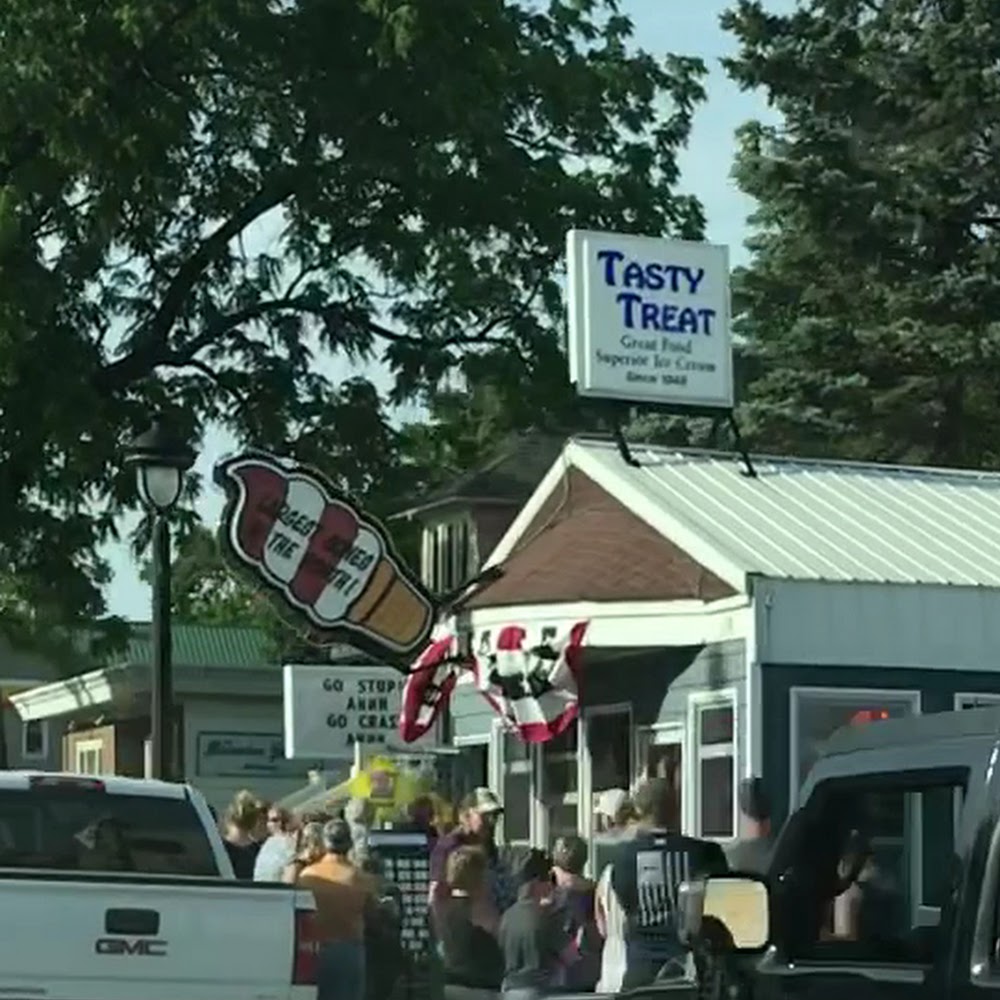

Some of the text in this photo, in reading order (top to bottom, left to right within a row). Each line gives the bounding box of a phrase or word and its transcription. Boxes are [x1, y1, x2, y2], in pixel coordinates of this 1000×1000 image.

[597, 250, 704, 294] TASTY
[616, 292, 716, 336] TREAT
[620, 334, 657, 351] Great
[267, 532, 300, 558] THE
[323, 678, 343, 692] GO
[327, 714, 347, 728] GO
[95, 938, 168, 956] GMC
